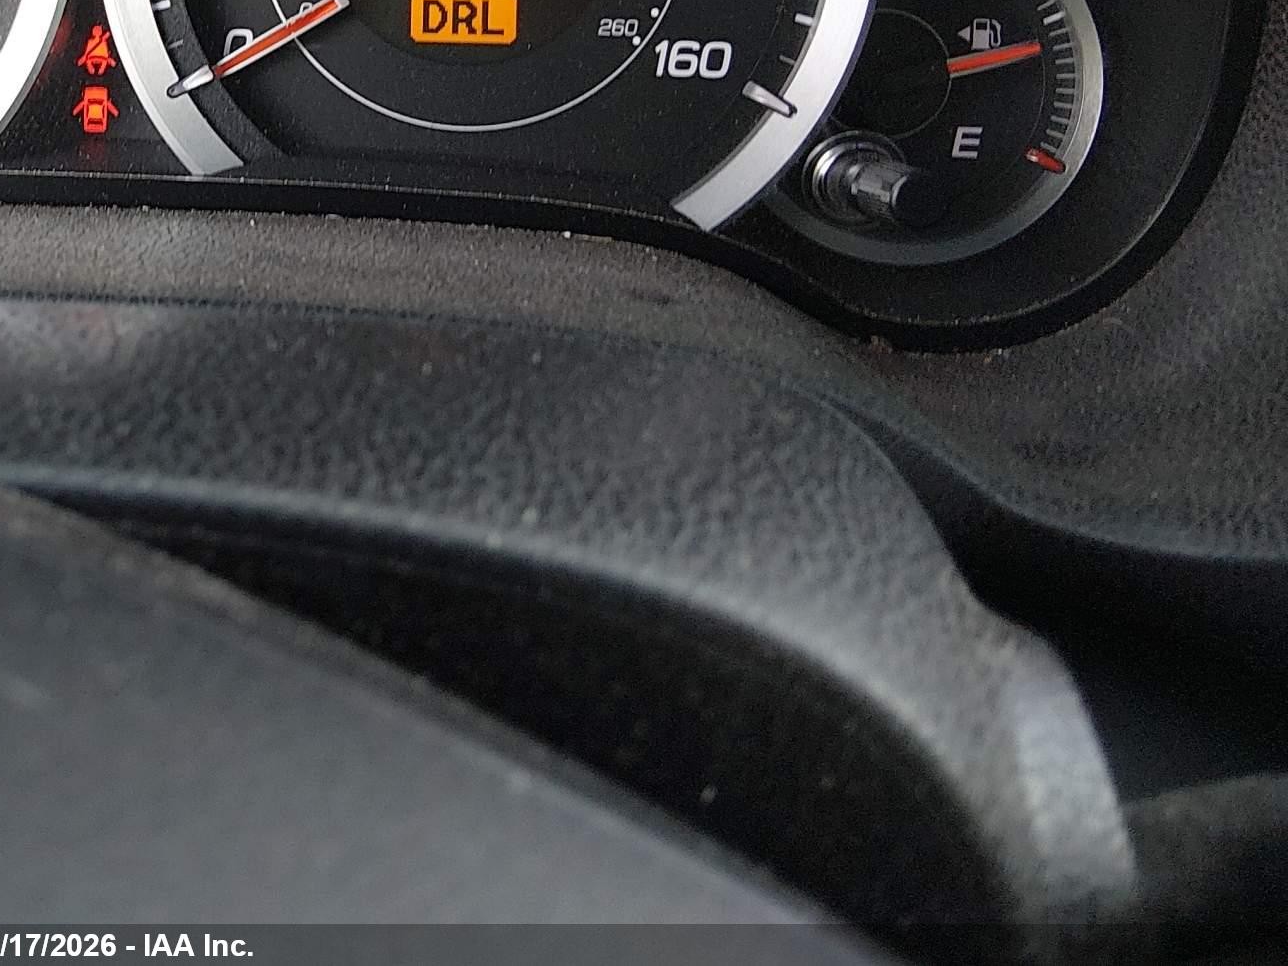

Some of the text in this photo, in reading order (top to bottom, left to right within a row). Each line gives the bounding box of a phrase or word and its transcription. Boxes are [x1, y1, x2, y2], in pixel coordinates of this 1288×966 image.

[598, 18, 639, 36] 260
[655, 40, 732, 78] 160
[951, 126, 983, 159] E
